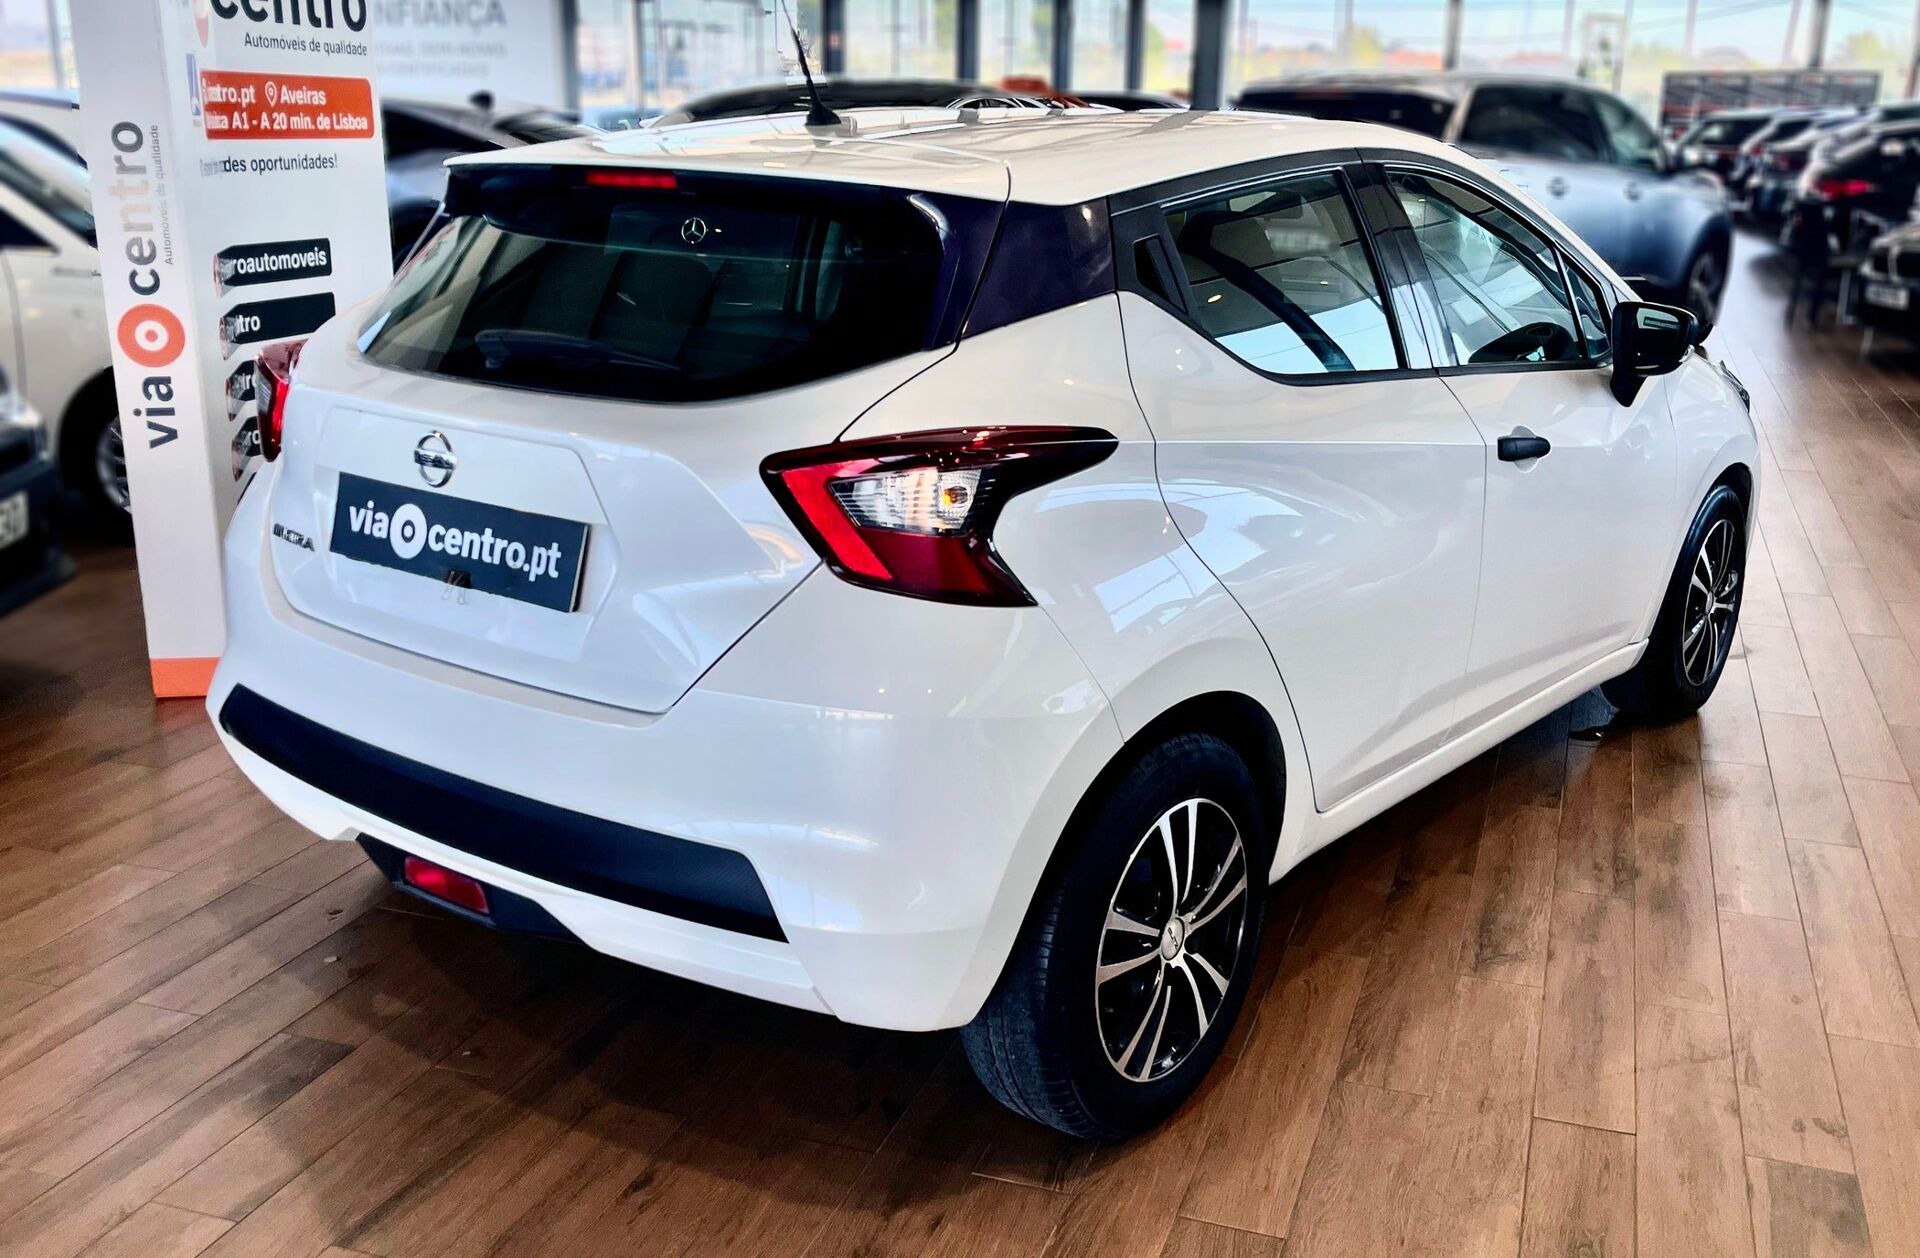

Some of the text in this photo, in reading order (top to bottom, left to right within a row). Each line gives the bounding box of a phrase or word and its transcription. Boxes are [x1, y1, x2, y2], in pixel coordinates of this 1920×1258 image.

[244, 32, 306, 51] Automóveis
[309, 38, 321, 52] de
[323, 42, 367, 56] qualidade
[280, 86, 327, 105] Aveiras
[232, 111, 249, 130] A1
[261, 111, 271, 130] A
[272, 111, 287, 130] 20
[290, 112, 315, 130] min.
[317, 112, 330, 130] de
[333, 113, 368, 130] Lisboa
[149, 124, 166, 180] qualidade
[250, 152, 338, 176] oportunidades!
[110, 121, 179, 450] via centro
[348, 500, 562, 582] via centro.pt
